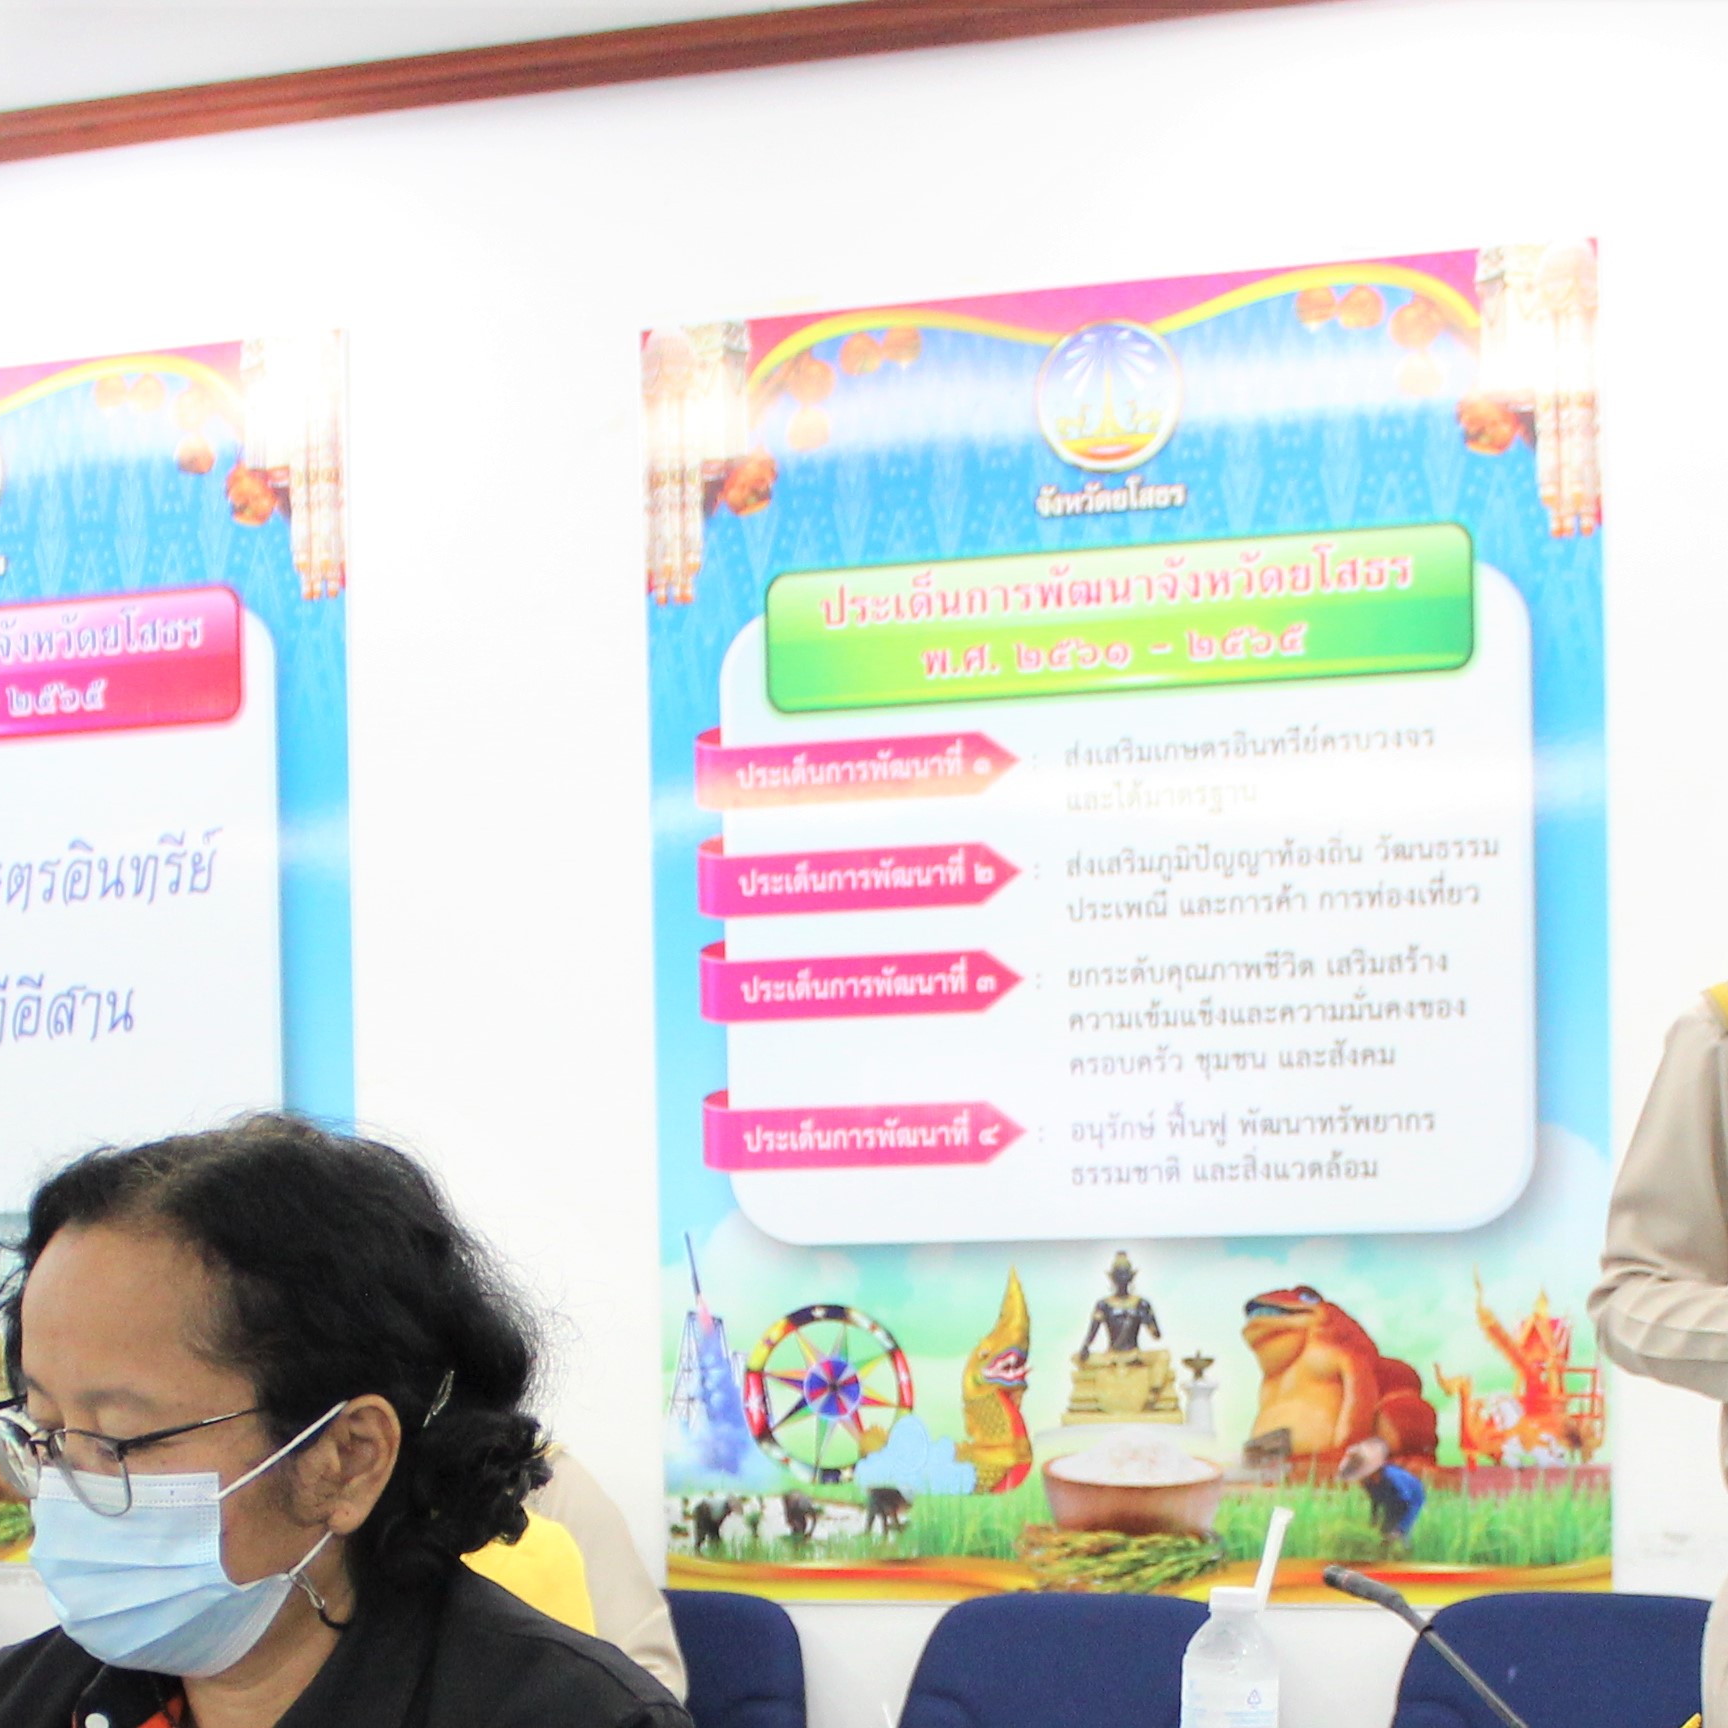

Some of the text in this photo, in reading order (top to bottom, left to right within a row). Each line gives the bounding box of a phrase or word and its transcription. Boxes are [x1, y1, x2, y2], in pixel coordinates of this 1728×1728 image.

[1036, 477, 1185, 517] จังหวัดยโสธร
[819, 546, 1413, 628] ประเด็นการพัฒนาจังหวัดยโสธร
[923, 642, 1000, 679] พ.ศ.
[1015, 632, 1130, 671] ๒๕๖๑
[1186, 622, 1308, 662] ๒๕๖๕
[5, 681, 105, 719] ๒๕๖๕
[736, 738, 962, 789] ประเด็นการพัฒนาที่
[1064, 724, 1436, 768] ส่งเสริมเกษตรอินทรีย์ครบวงจร
[739, 849, 994, 897] ประเด็นการพัฒนาที่ ๒
[1066, 830, 1499, 882] ส่งเสริมภูมิปัญญาท้องถิ่น วัฒนธรรม
[1066, 875, 1481, 924] ประเพณี และการค้า การท่องเที่ยว
[741, 957, 967, 1003] ประเด็นการพัฒนาที่
[1068, 944, 1449, 993] ยกระดับคุณภาพชีวิต เสริมสร้าง
[1068, 989, 1467, 1033] ความเข้มแข็งและความมั่นคงของ
[1069, 1038, 1396, 1081] ครอบครัว ชุมชน และสังคม
[744, 1110, 969, 1152] ประเด็นการพัฒนาที่
[1070, 1101, 1436, 1150] อนุรักษ์ ฟื้นฟู พัฒนาทรัพยากร
[1071, 1147, 1379, 1186] ธรรมชาติ และสิ่งแวดล้อม
